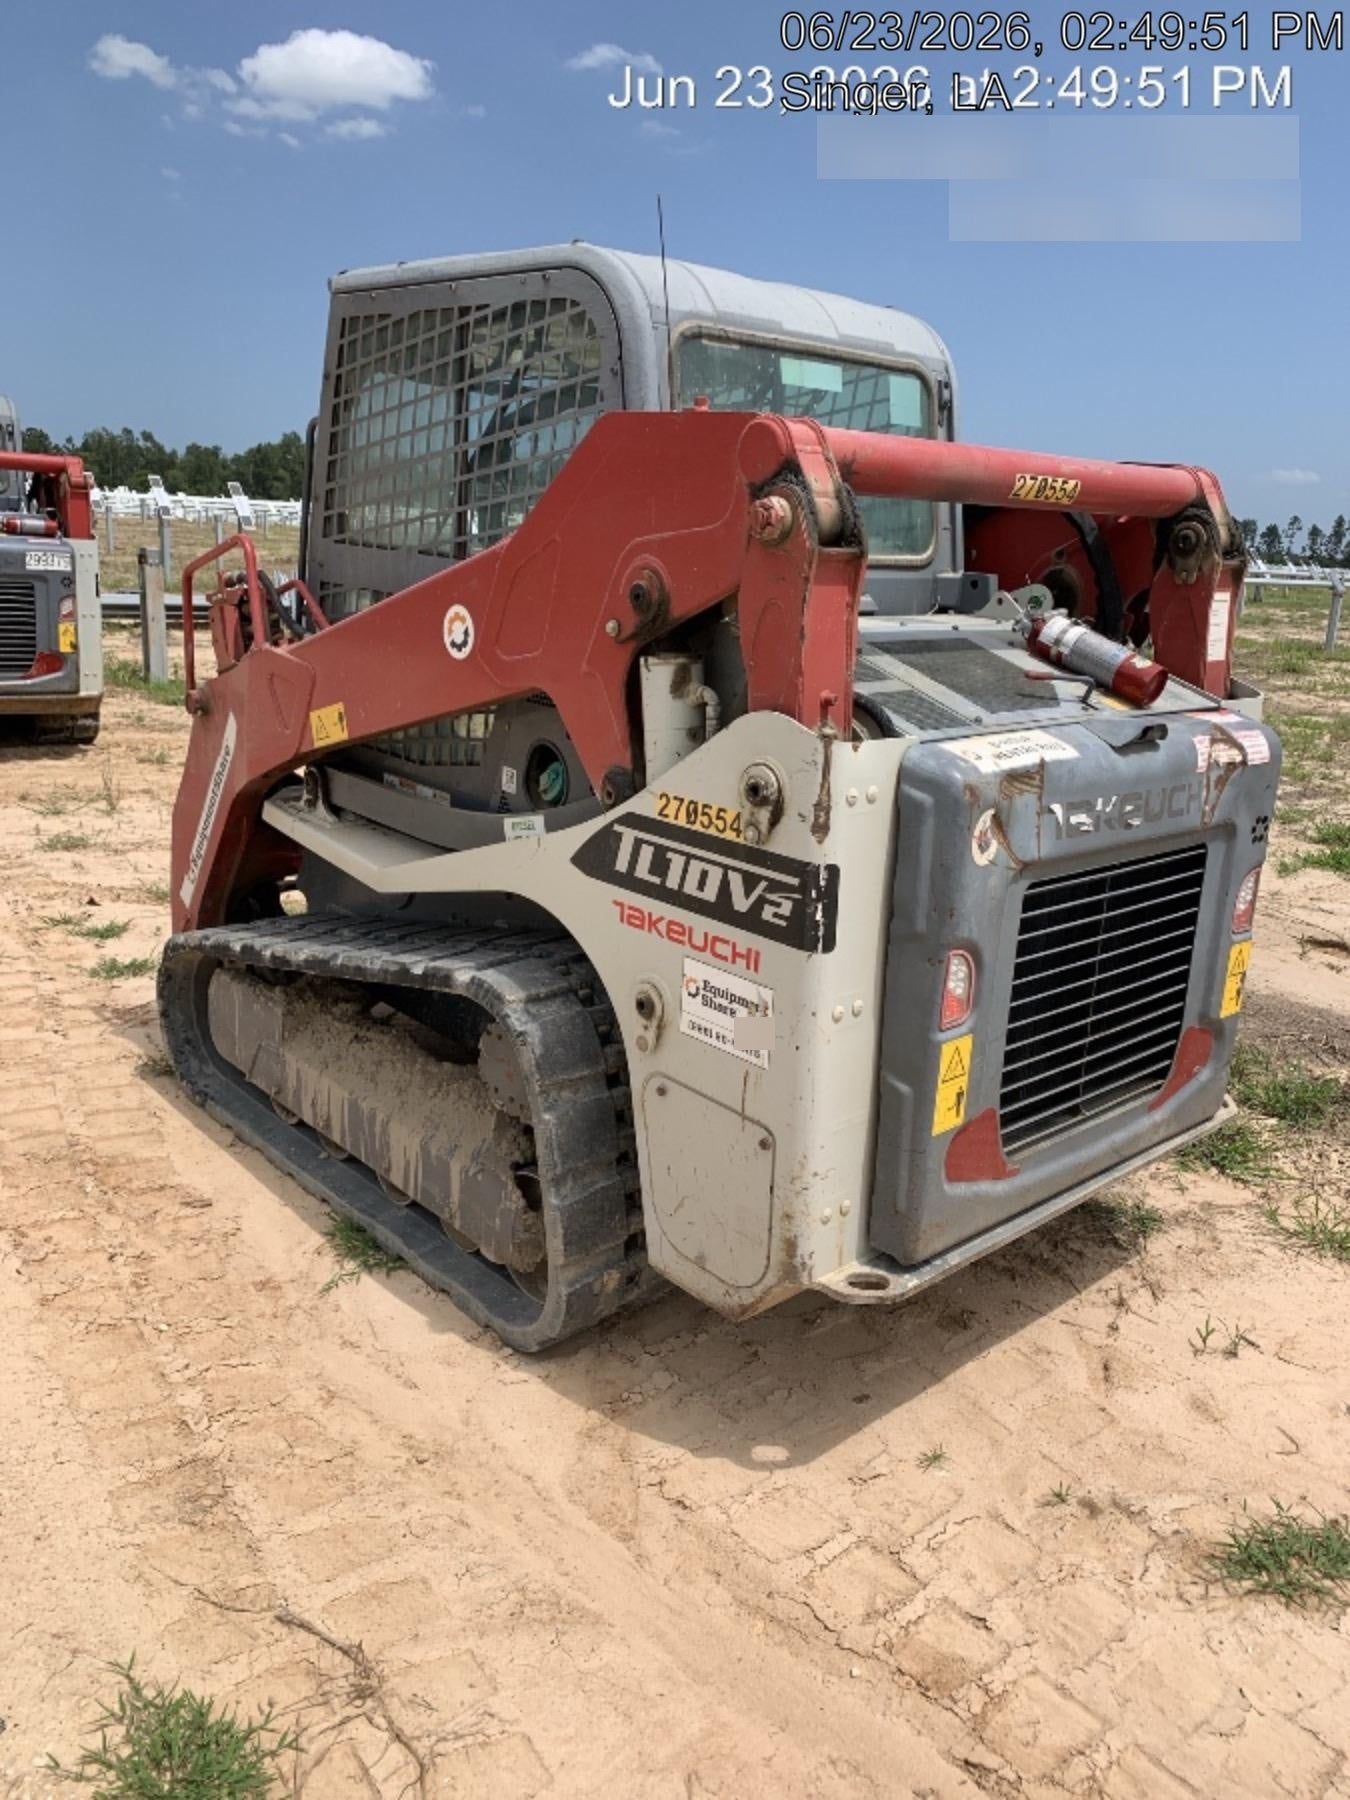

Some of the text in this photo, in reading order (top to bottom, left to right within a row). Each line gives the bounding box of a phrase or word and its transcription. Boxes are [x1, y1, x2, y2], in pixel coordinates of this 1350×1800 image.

[1011, 475, 1080, 502] 270554
[657, 792, 744, 839] 270554
[1049, 783, 1206, 840] TAKEUCH
[702, 979, 769, 1017] Equipm
